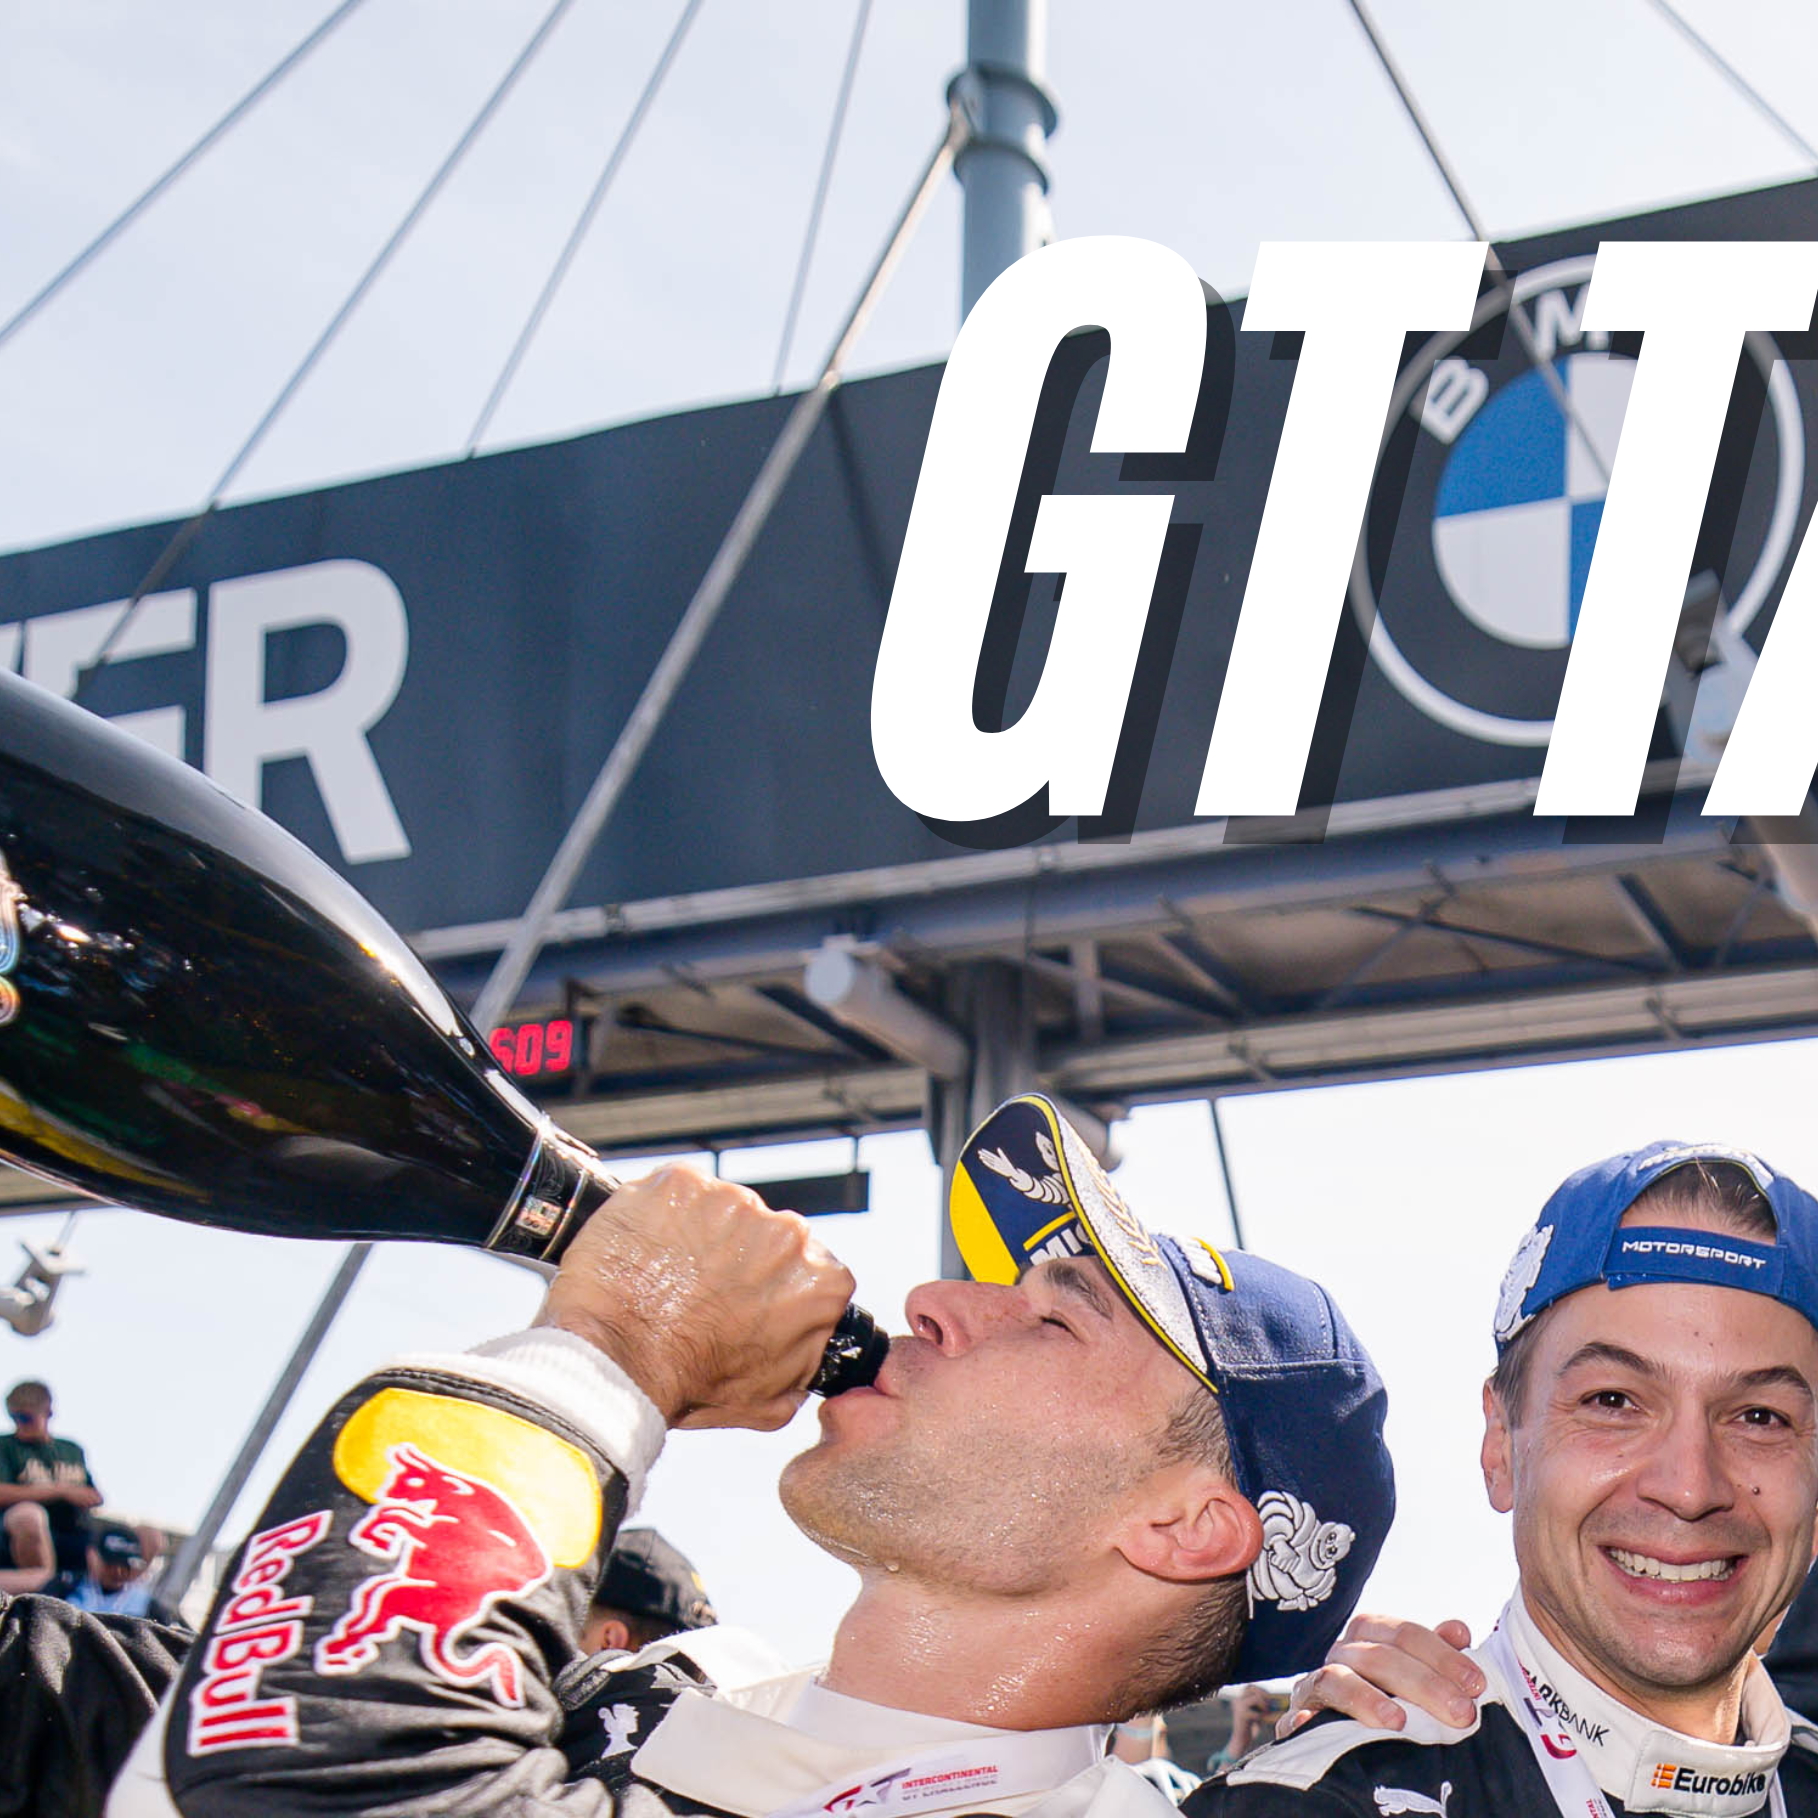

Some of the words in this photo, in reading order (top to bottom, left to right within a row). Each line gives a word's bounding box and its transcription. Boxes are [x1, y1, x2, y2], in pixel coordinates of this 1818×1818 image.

[1622, 1240, 1767, 1270] MOTORSPORT
[901, 1764, 999, 1790] INTERCONTINENTAL
[1673, 1767, 1767, 1796] Eurobike
